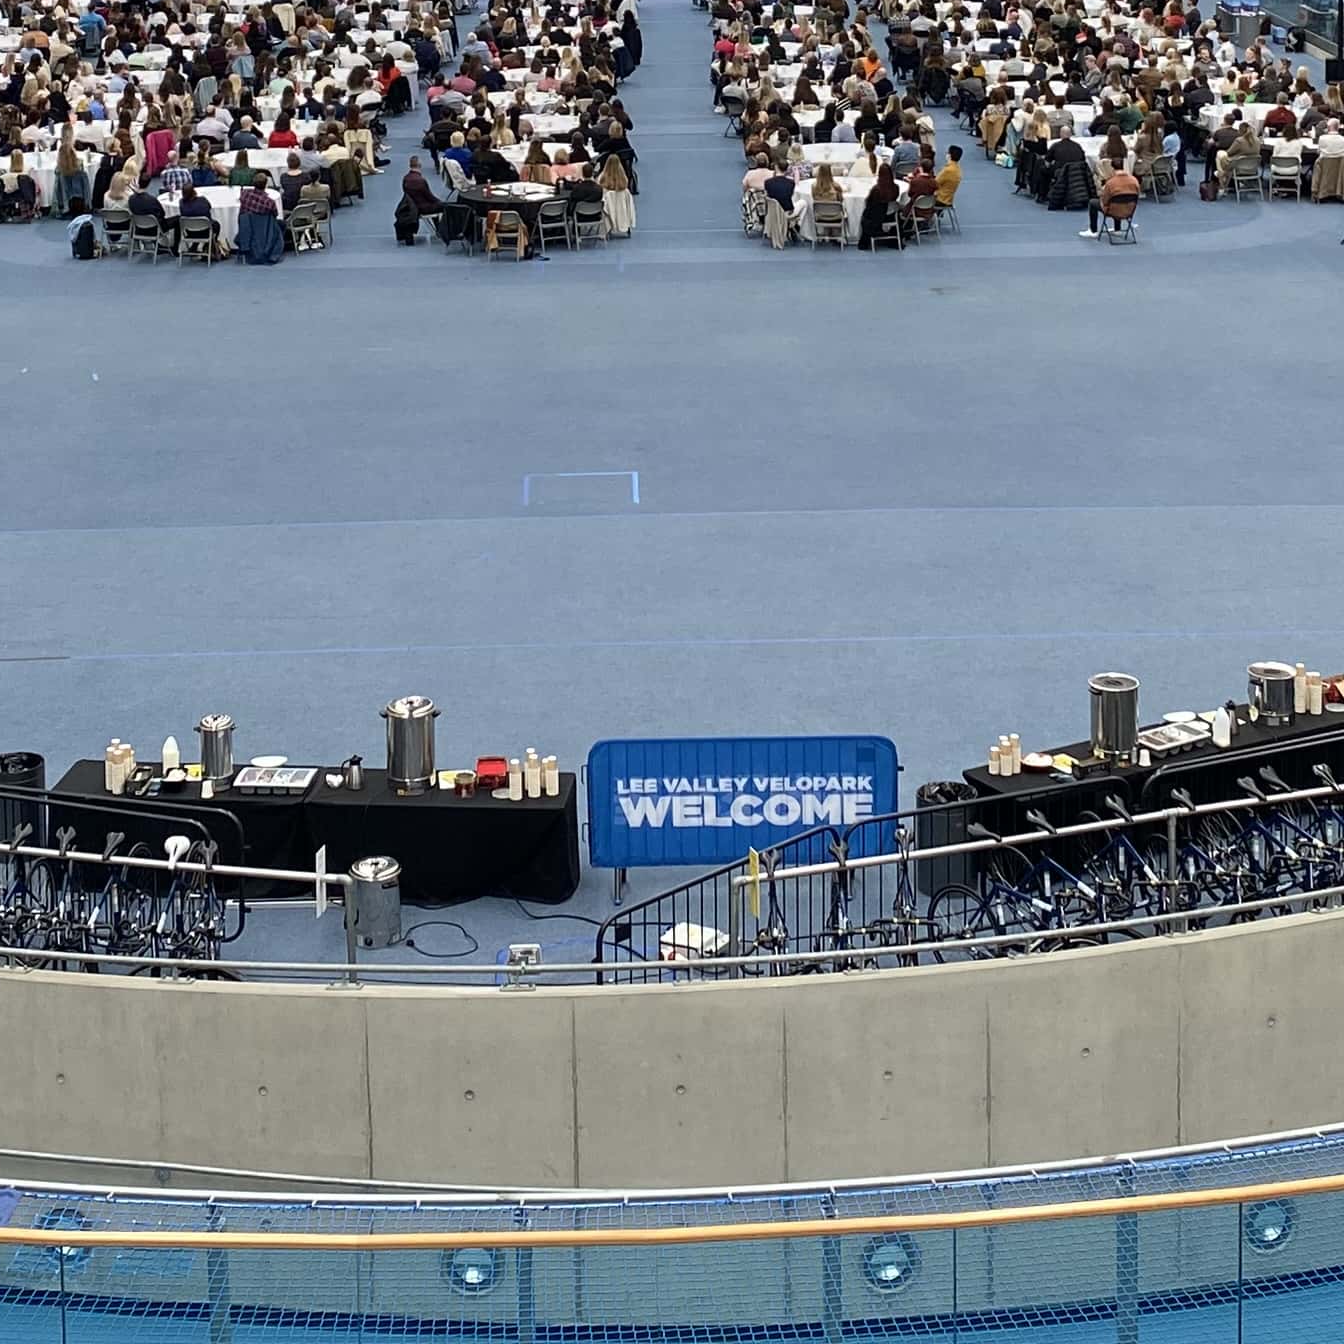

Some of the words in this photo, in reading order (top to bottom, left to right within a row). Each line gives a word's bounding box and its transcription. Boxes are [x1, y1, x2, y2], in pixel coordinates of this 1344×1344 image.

[616, 778, 657, 795] LEE
[662, 777, 750, 794] VALLEY
[752, 775, 873, 793] VELOPARK
[618, 793, 874, 828] WELCOME
